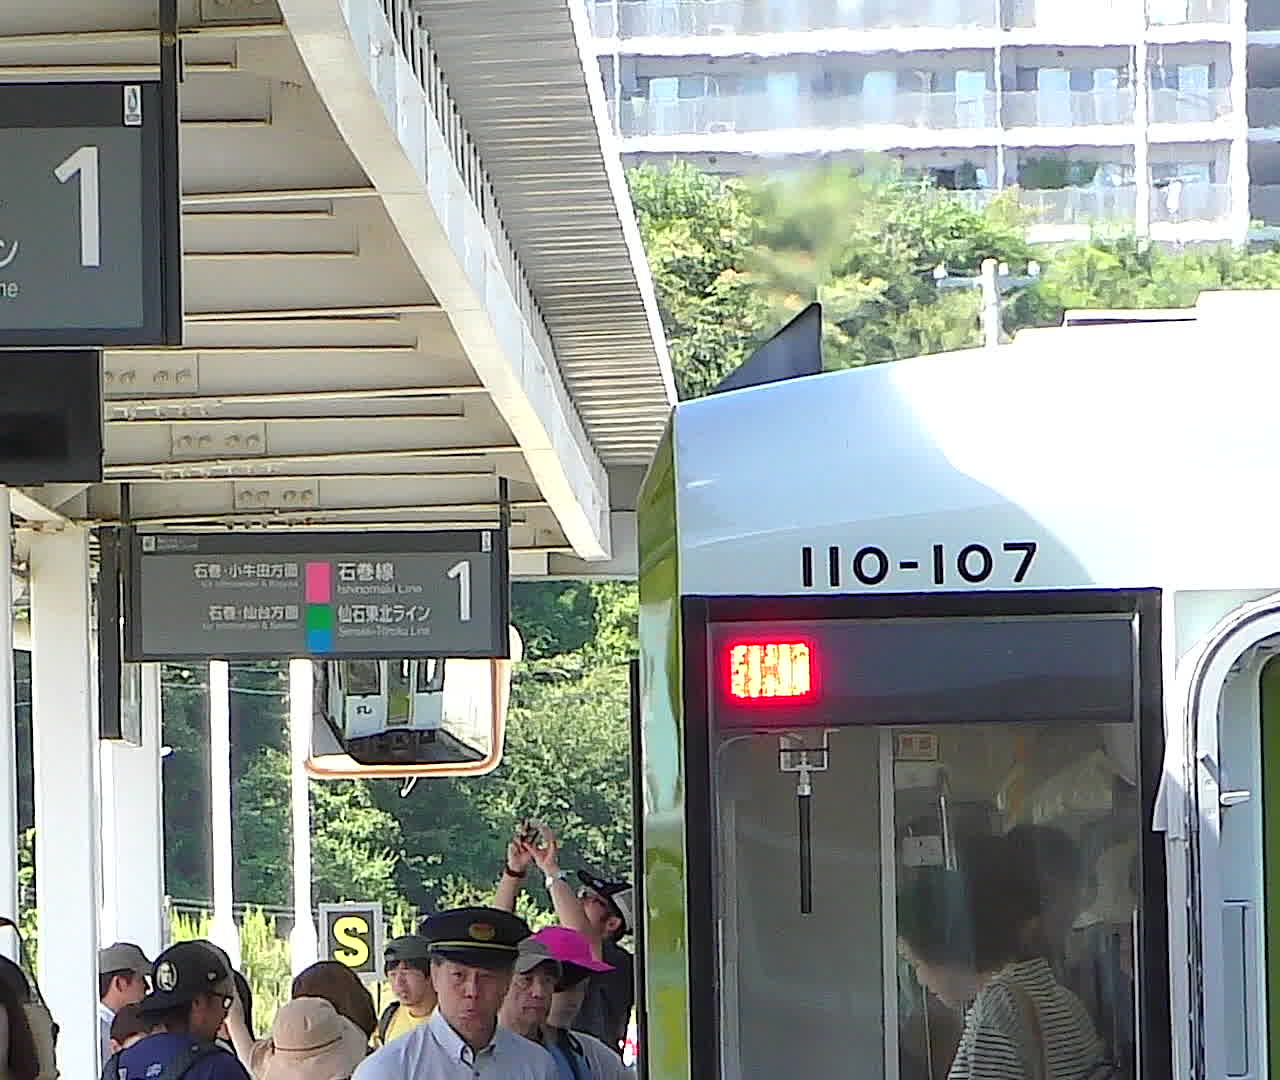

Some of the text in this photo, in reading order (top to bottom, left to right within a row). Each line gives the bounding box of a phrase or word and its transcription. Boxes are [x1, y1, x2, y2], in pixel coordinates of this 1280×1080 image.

[53, 146, 100, 267] 1
[447, 560, 470, 621] 1
[801, 542, 1037, 588] 110-107
[332, 914, 370, 968] S
